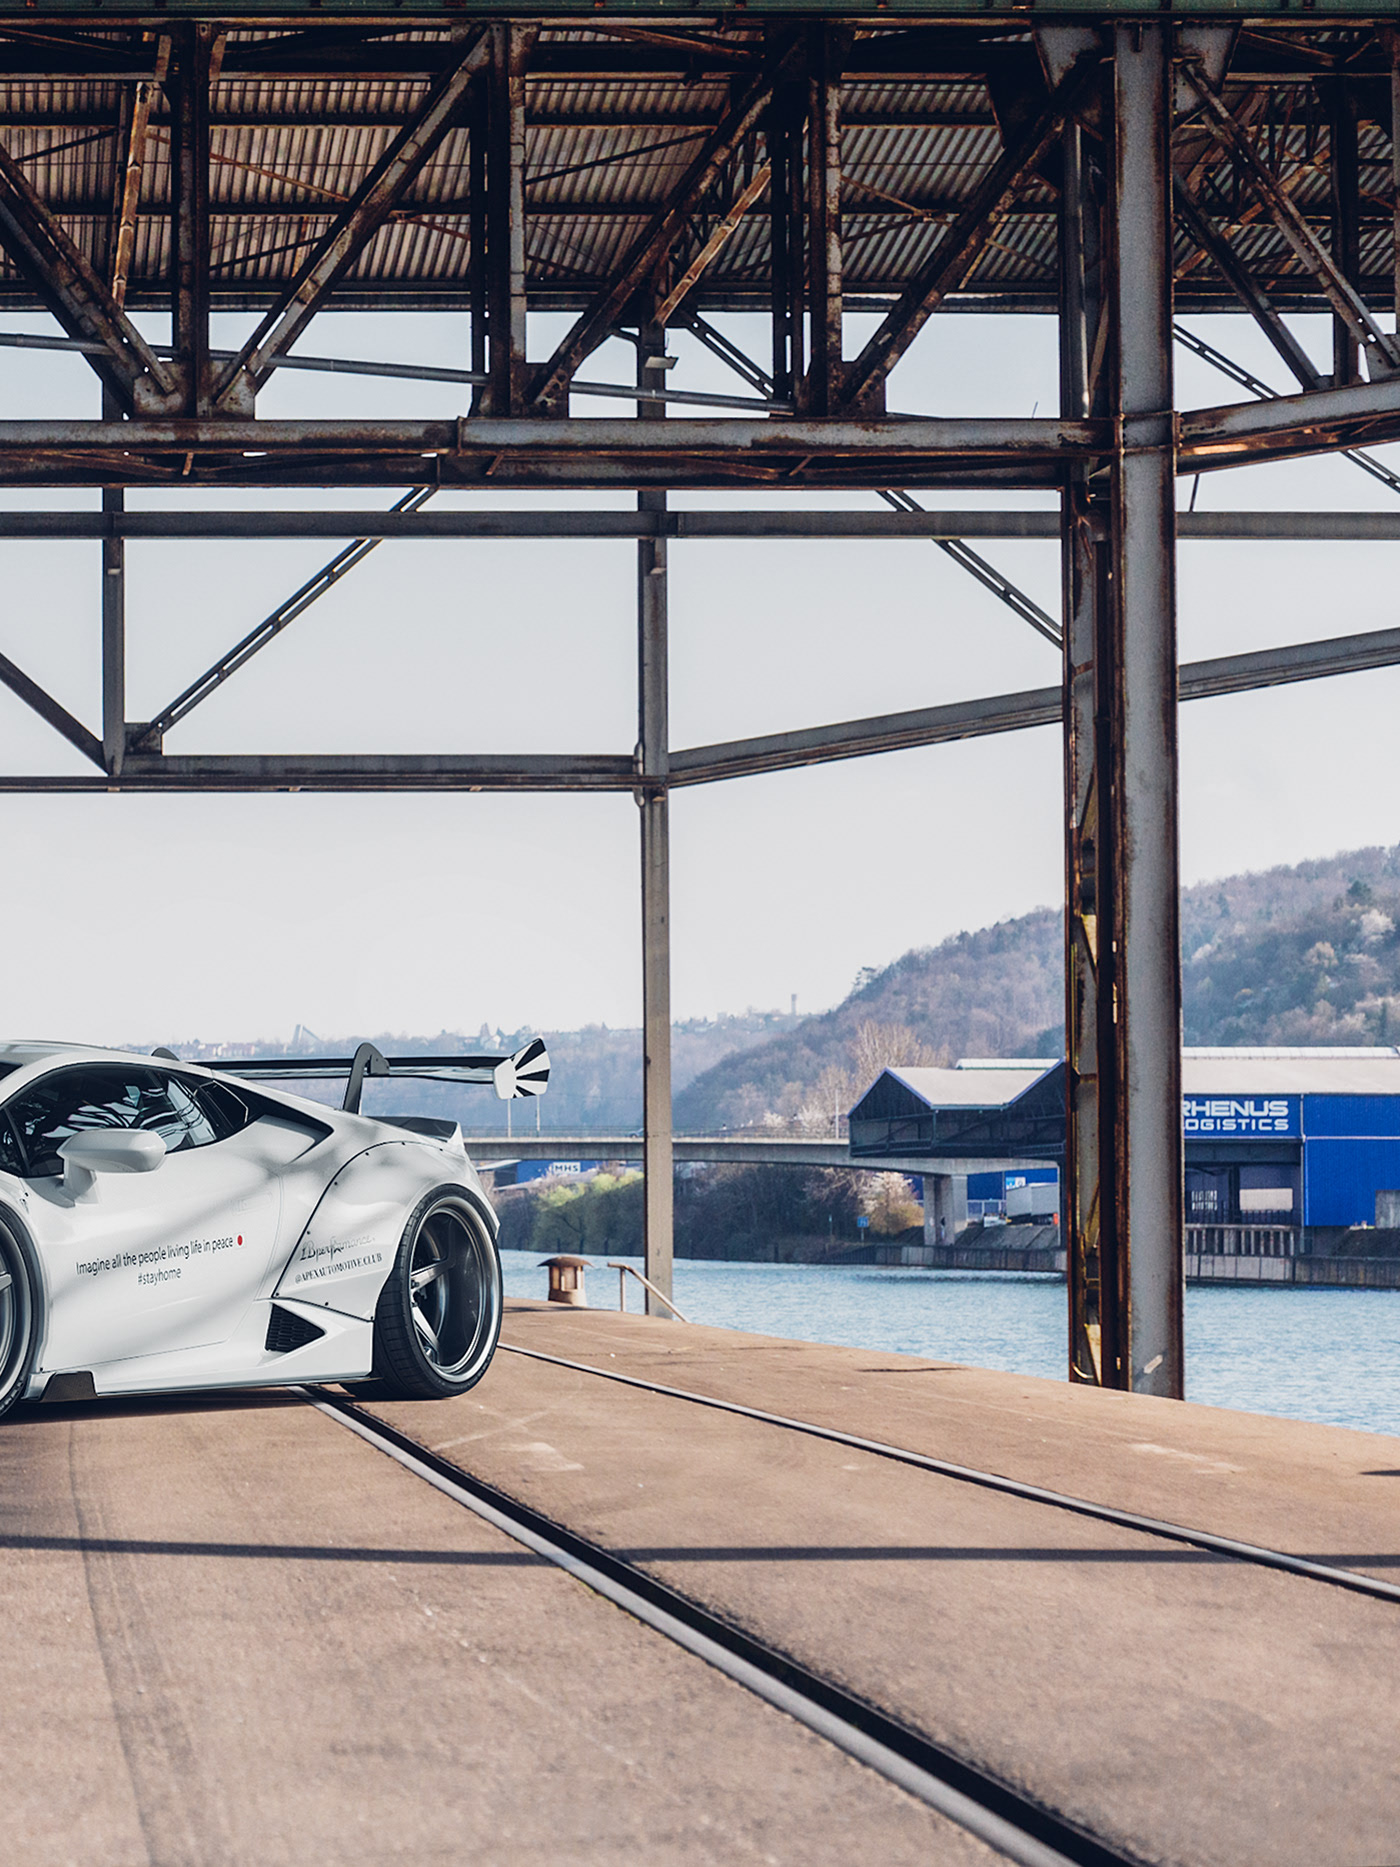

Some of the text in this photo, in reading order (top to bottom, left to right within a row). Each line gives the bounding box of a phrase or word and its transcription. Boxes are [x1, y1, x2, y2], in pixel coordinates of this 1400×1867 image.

[1182, 1100, 1289, 1117] RHENUS
[1183, 1118, 1289, 1131] OGISTICS
[75, 1236, 234, 1277] Imagine all the people living life in peace
[137, 1266, 182, 1287] #stayhome
